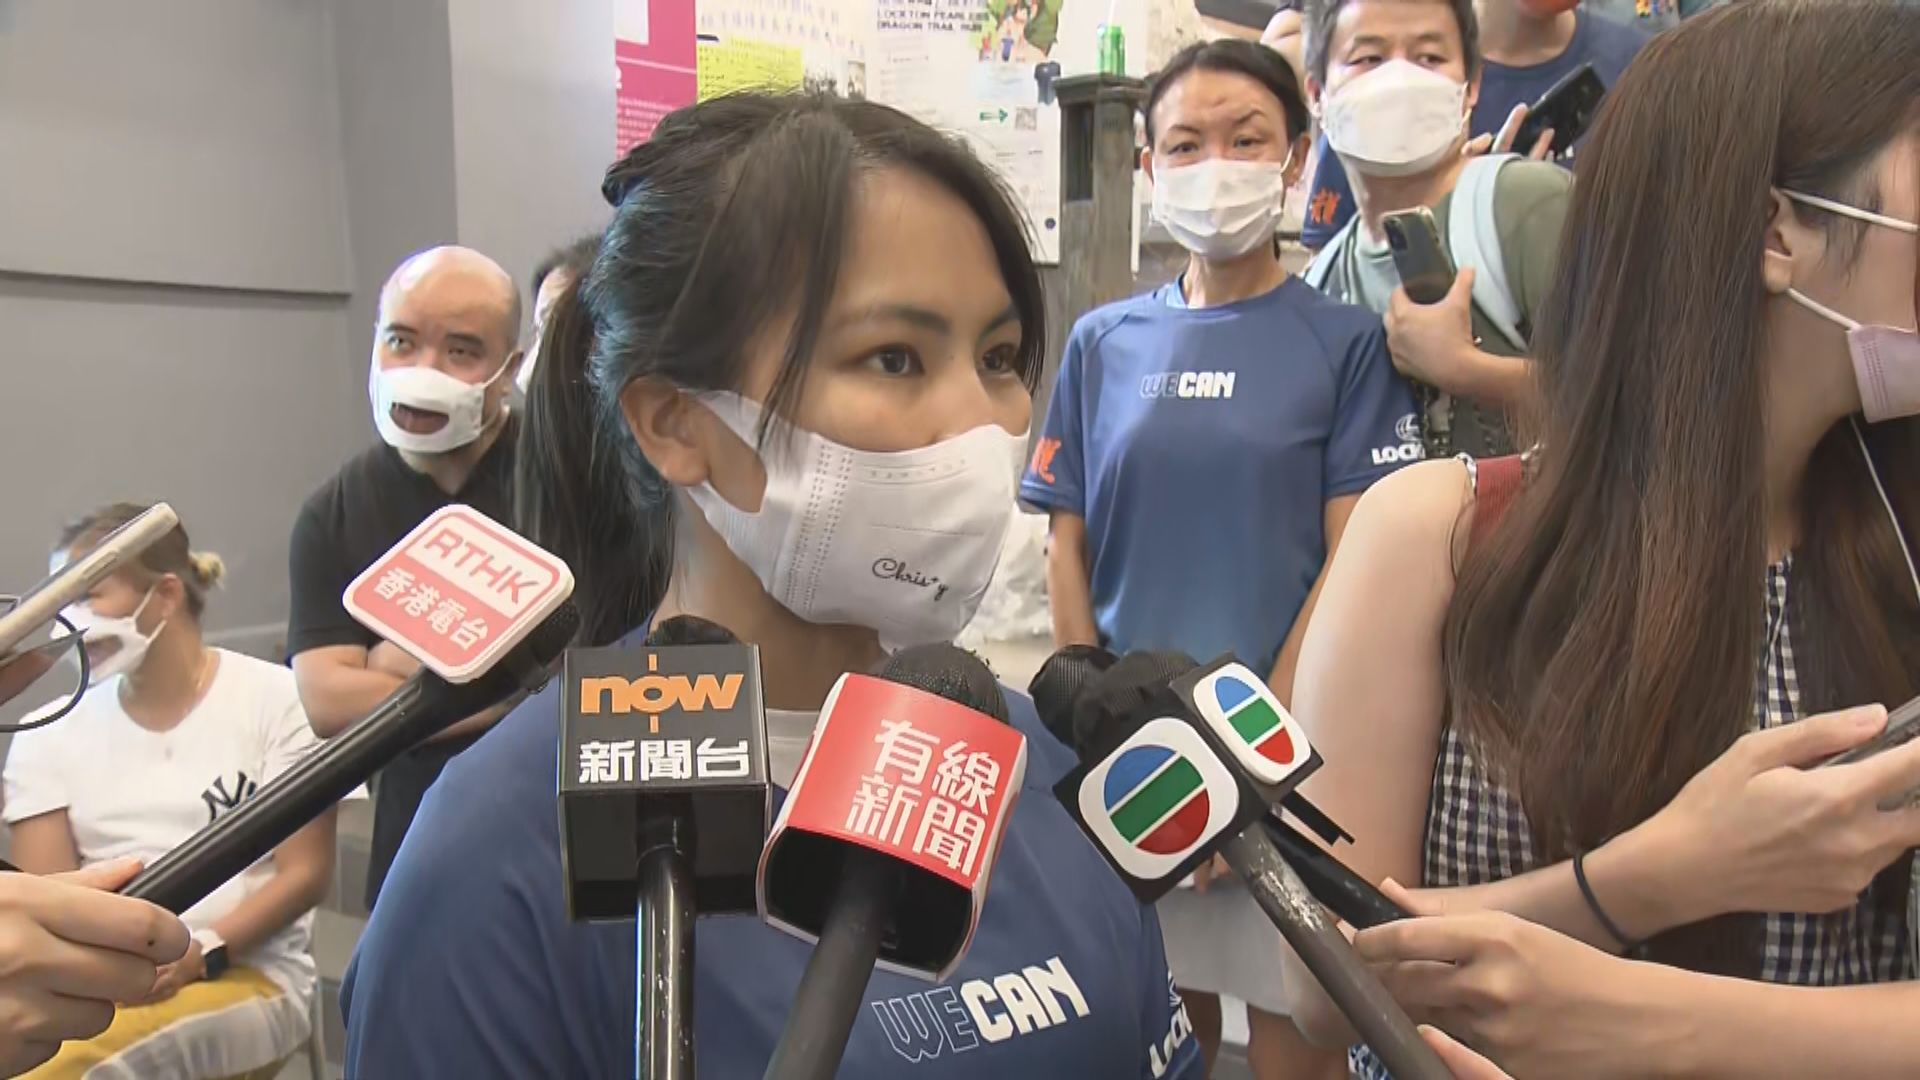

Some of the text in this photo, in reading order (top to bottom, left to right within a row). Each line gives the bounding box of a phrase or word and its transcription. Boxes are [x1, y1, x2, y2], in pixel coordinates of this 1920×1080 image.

[373, 566, 489, 652] 香港電台
[424, 527, 539, 605] RTHK
[579, 673, 744, 714] now
[578, 737, 750, 784] 新聞台
[871, 718, 1001, 816] 有線
[844, 773, 986, 877] 新聞
[871, 956, 1091, 1063] WECAN
